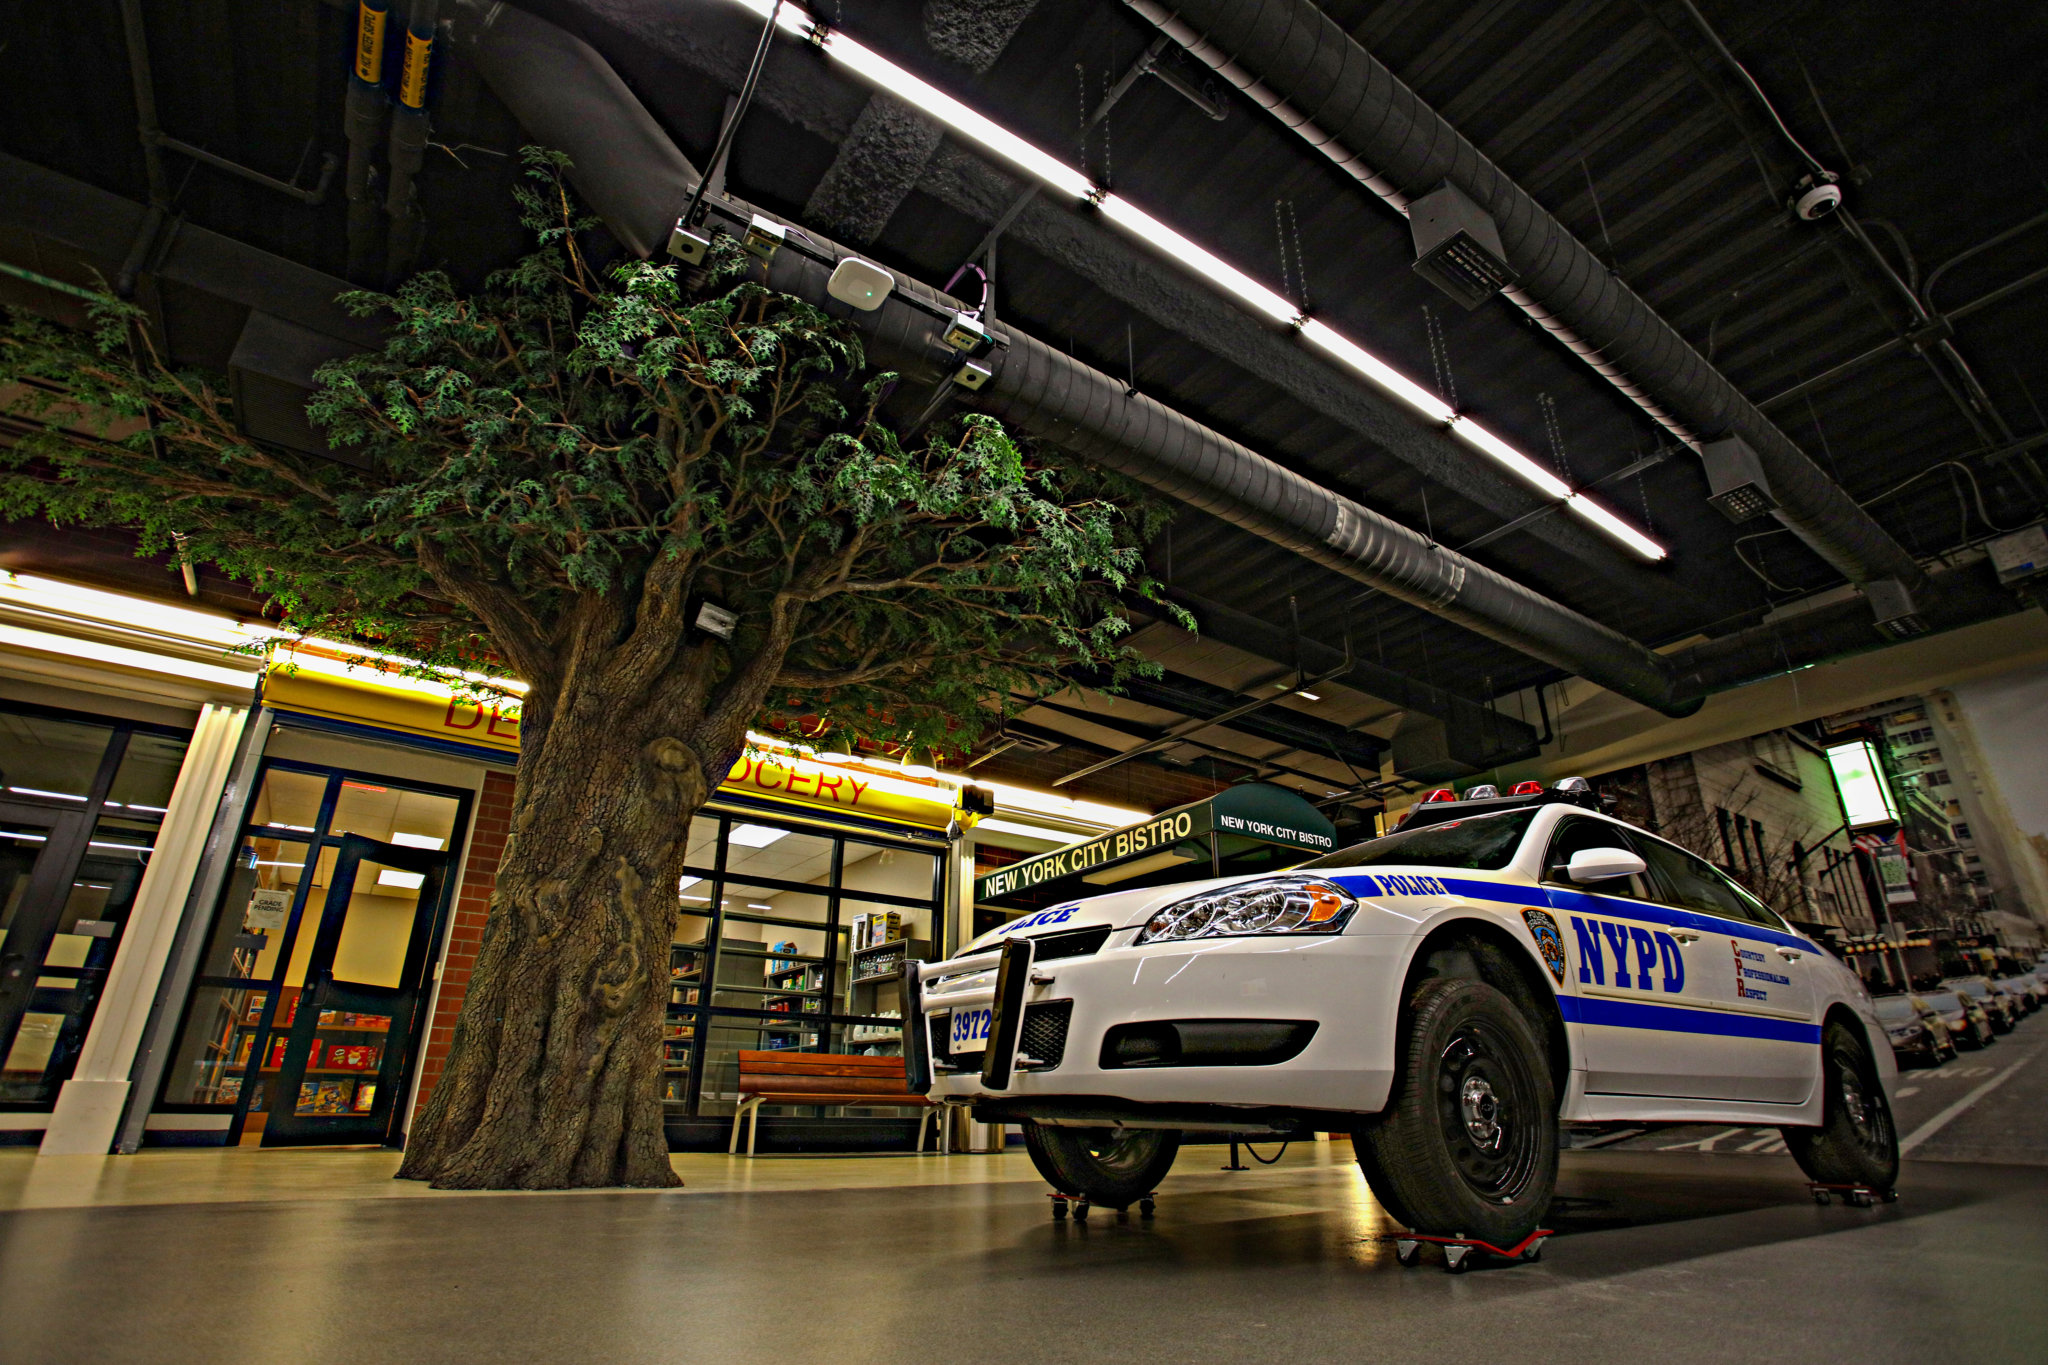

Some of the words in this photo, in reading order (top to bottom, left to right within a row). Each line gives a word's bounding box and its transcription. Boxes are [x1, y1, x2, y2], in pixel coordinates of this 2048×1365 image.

[444, 693, 519, 740] DE
[725, 756, 870, 806] OCERY
[1220, 814, 1244, 830] NEW
[1246, 820, 1275, 836] YORK
[1276, 826, 1297, 841] CITY
[1298, 831, 1333, 848] BISTRO
[985, 869, 1018, 898] NEW
[1021, 853, 1067, 886] YORK
[1071, 838, 1111, 871] CITY
[1116, 812, 1192, 857] BISTRO
[1374, 874, 1447, 897] POLICE
[998, 907, 1080, 935] LICE
[1569, 915, 1685, 994] NYPD
[953, 1009, 992, 1042] 3972
